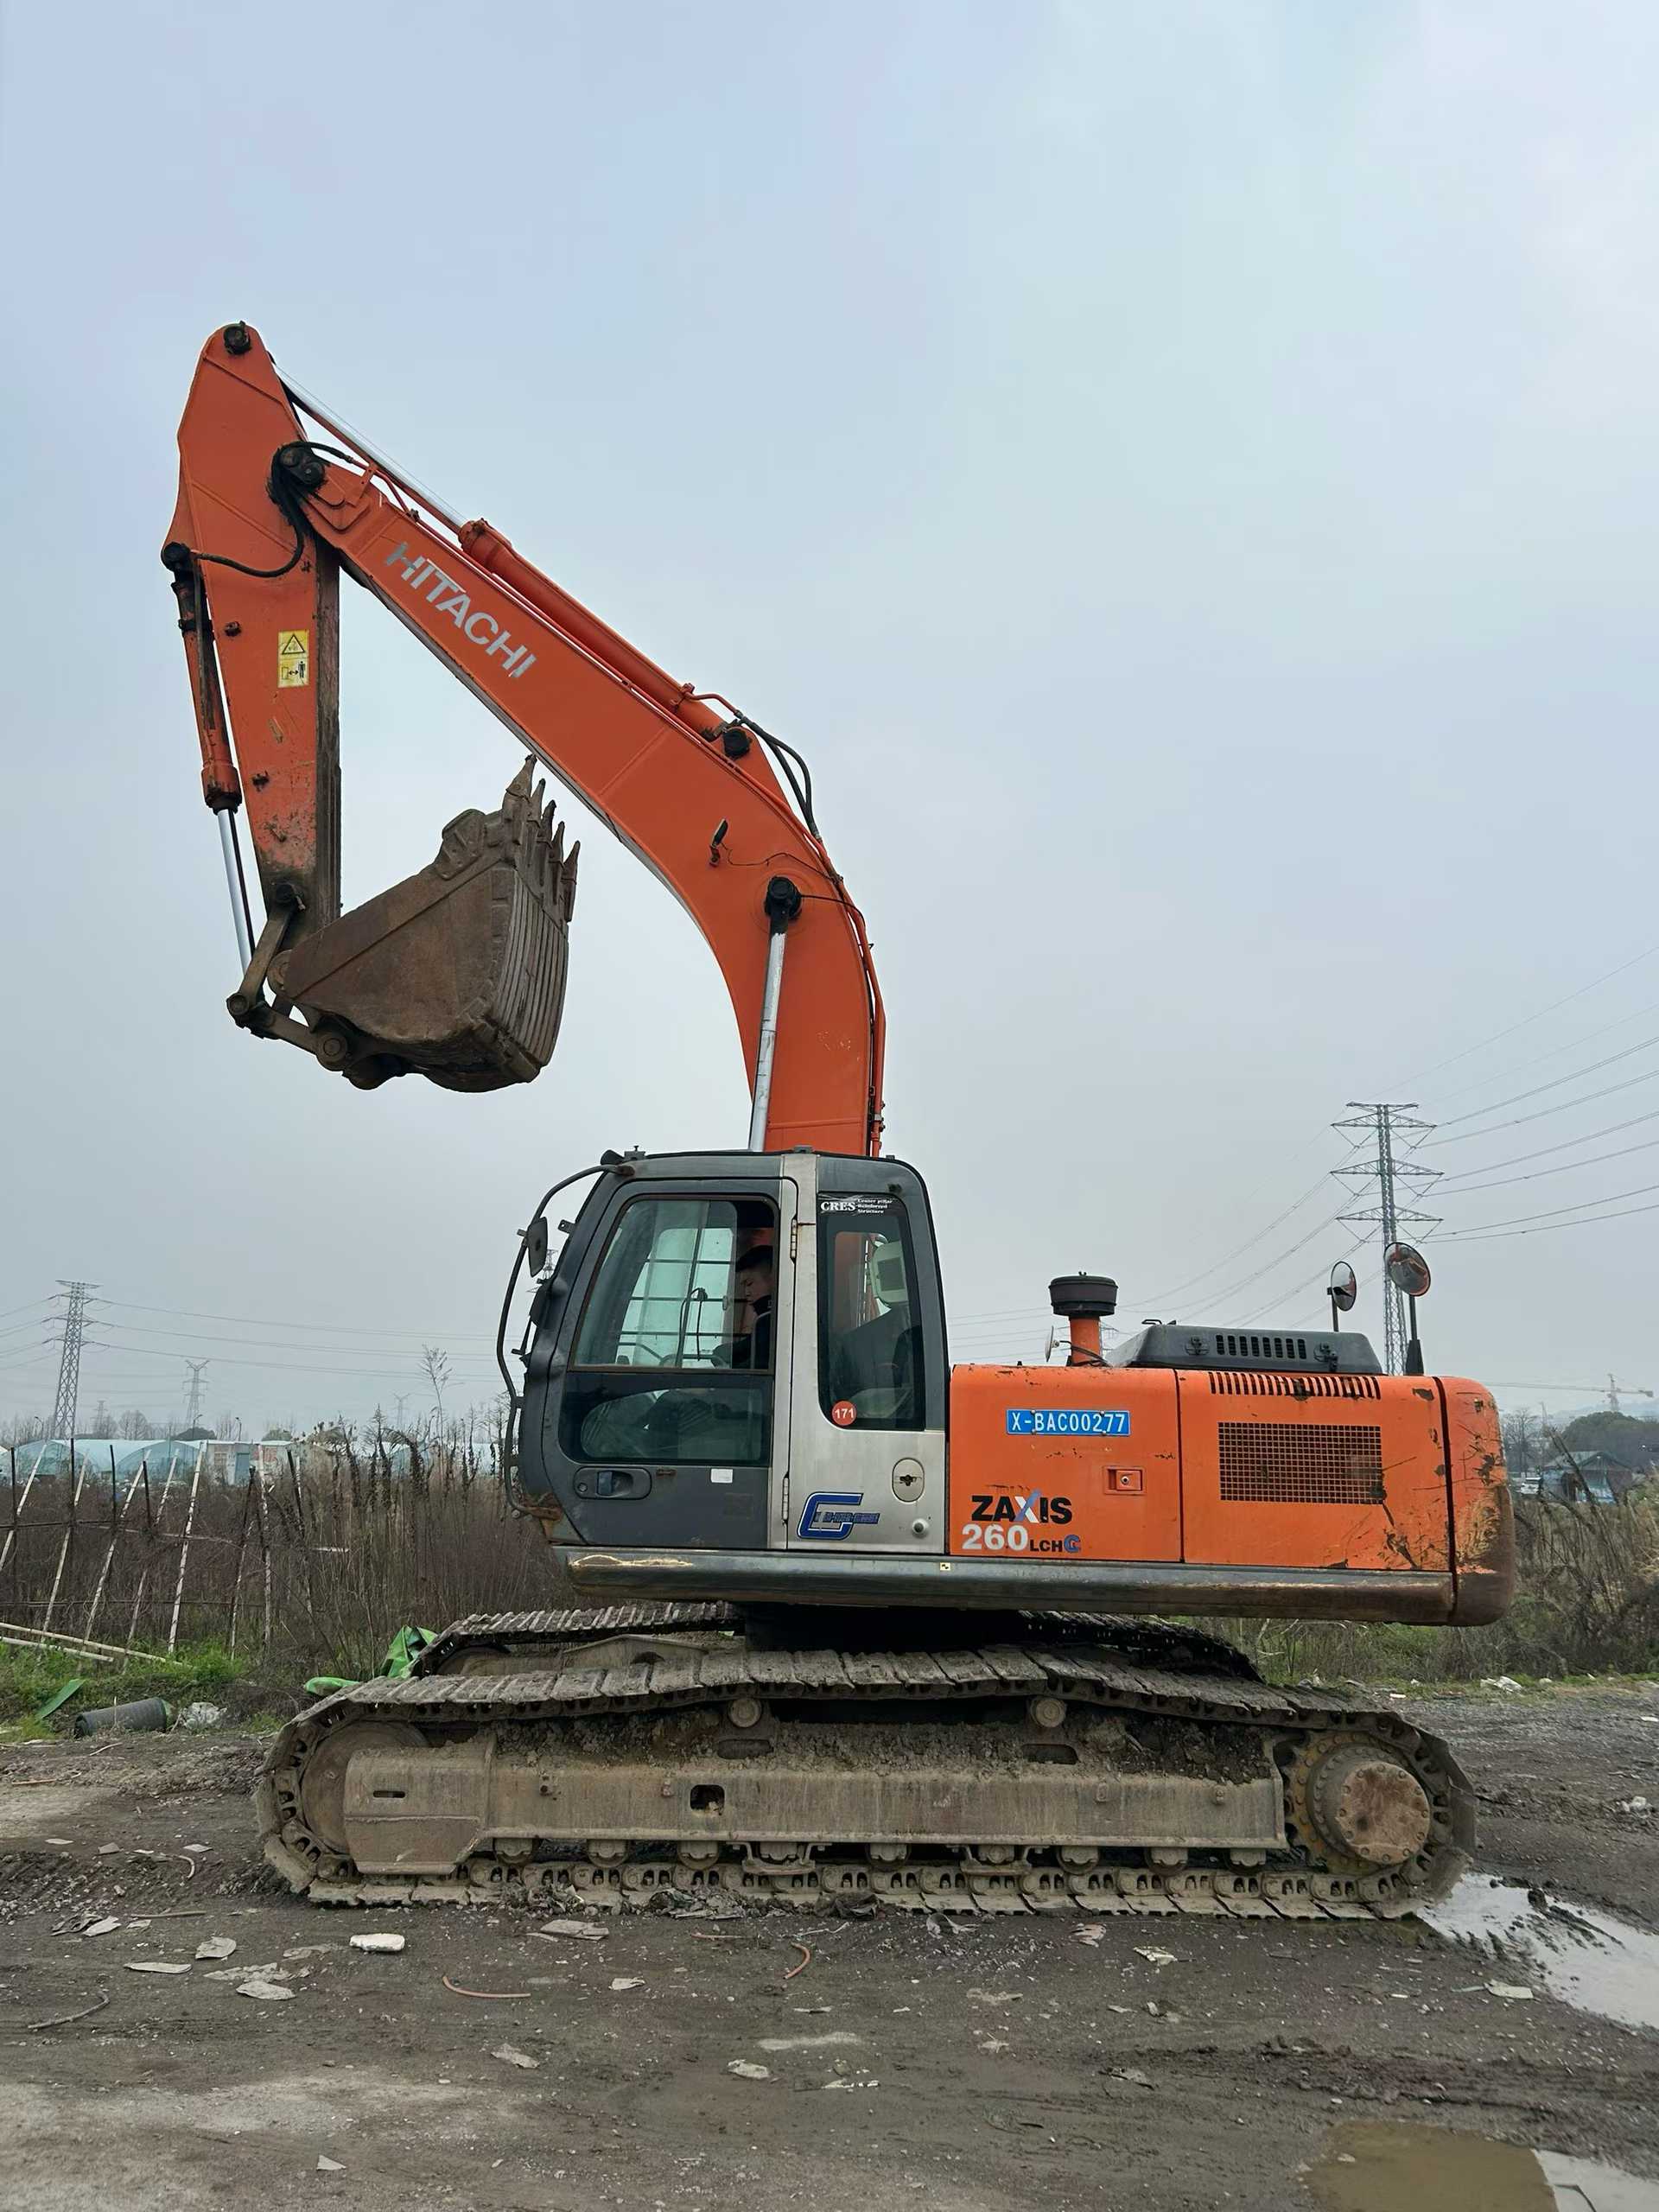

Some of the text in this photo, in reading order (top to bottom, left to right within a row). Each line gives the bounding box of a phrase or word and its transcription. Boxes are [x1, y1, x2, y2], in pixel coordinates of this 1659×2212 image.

[385, 541, 537, 678] HITACHI
[820, 1201, 856, 1211] CRES
[834, 1408, 855, 1420] 171
[1011, 1412, 1125, 1433] X-BAC00277
[971, 1490, 1073, 1524] ZAXIS
